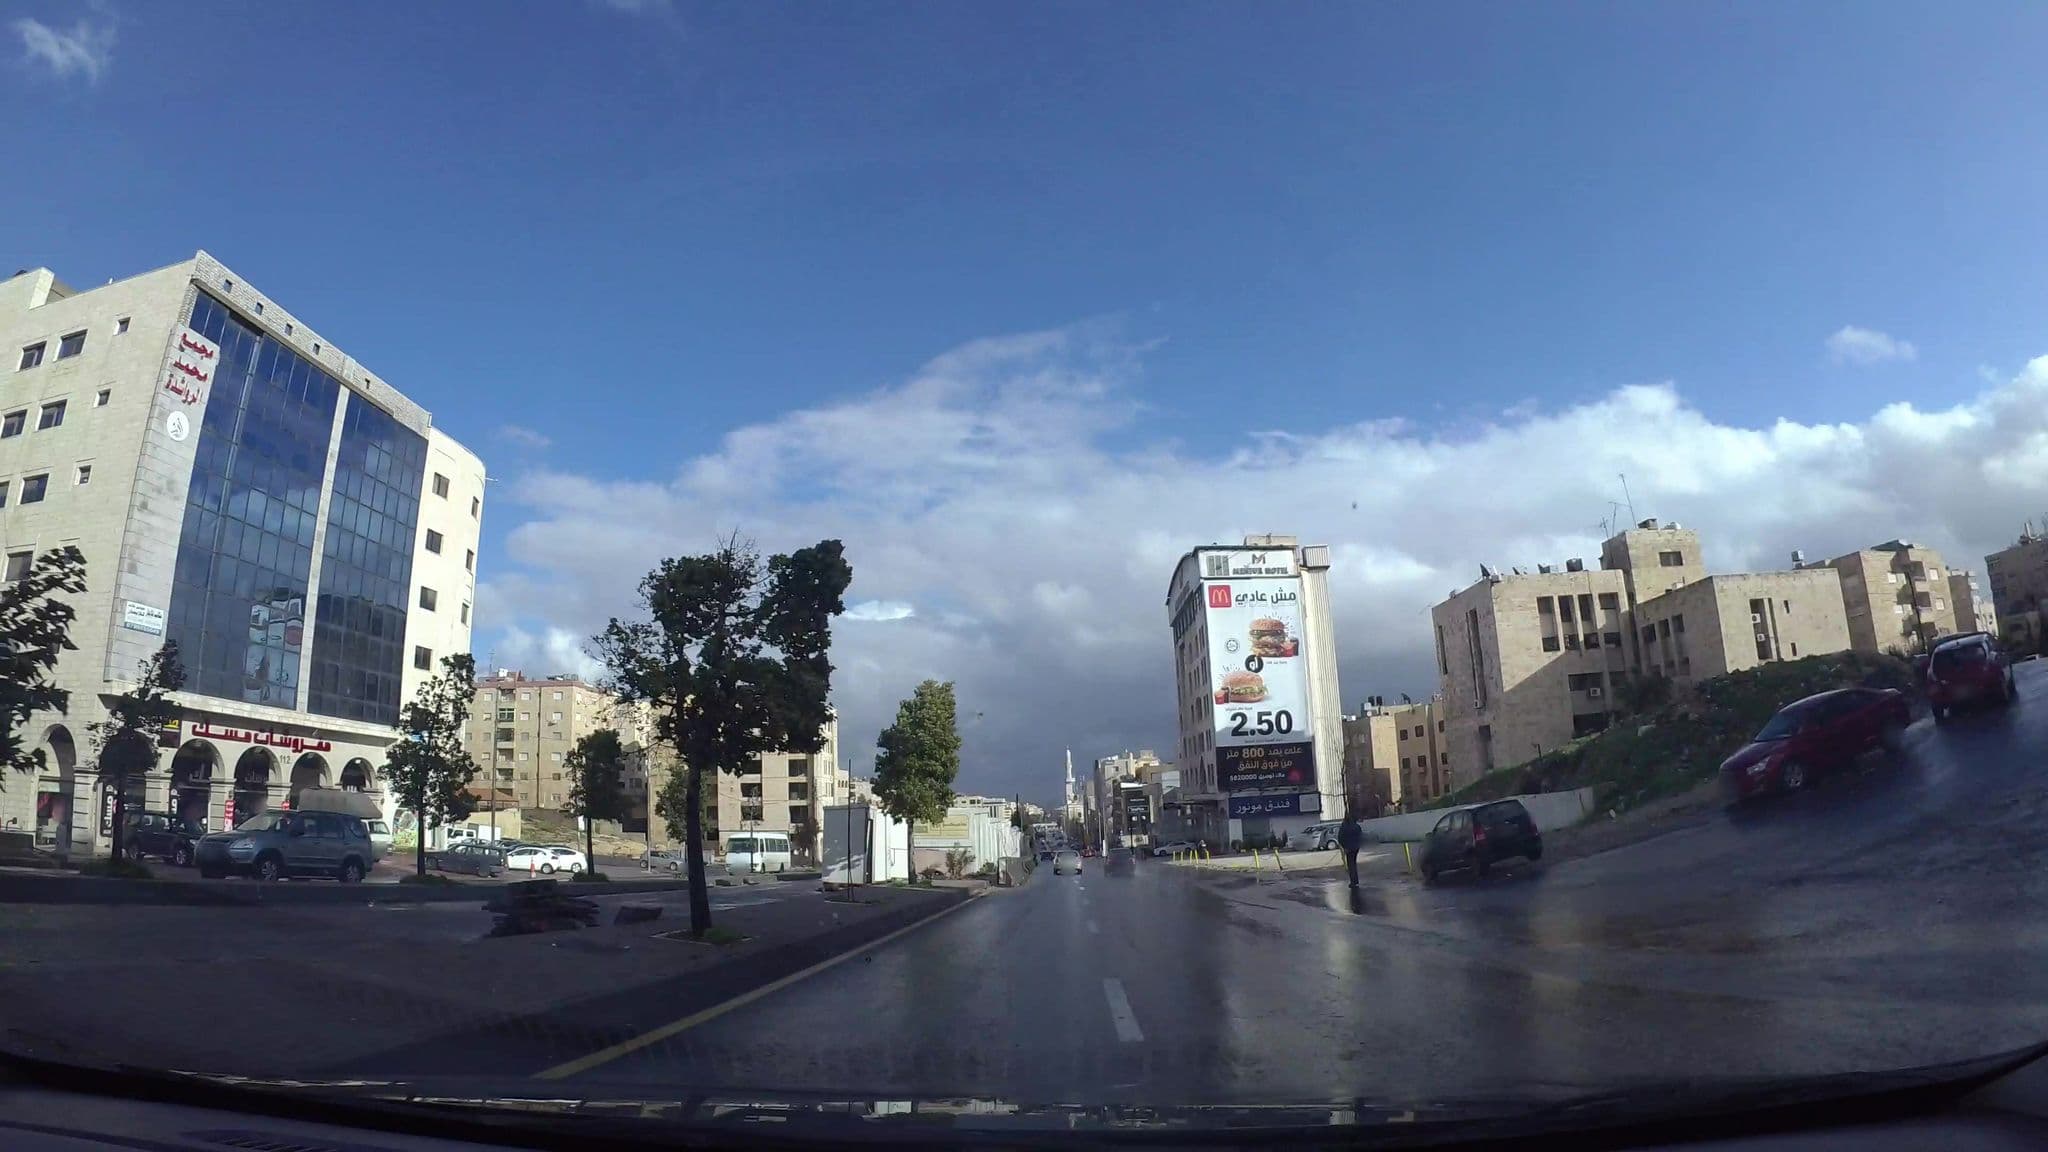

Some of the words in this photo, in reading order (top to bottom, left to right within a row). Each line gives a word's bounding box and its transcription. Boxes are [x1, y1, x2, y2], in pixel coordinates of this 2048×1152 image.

[1265, 566, 1289, 575] HOTEL
[1235, 590, 1268, 605] عادي
[1271, 587, 1296, 604] مش
[1230, 709, 1293, 737] 2.50
[191, 719, 252, 743] مسك
[253, 728, 332, 753] مفروشات
[1242, 747, 1265, 759] 800
[279, 755, 291, 765] 112
[1237, 760, 1260, 772] النفق
[1261, 759, 1280, 770] فوق
[1281, 758, 1293, 769] من
[1234, 802, 1262, 815] مونور
[1264, 798, 1290, 812] فندق
